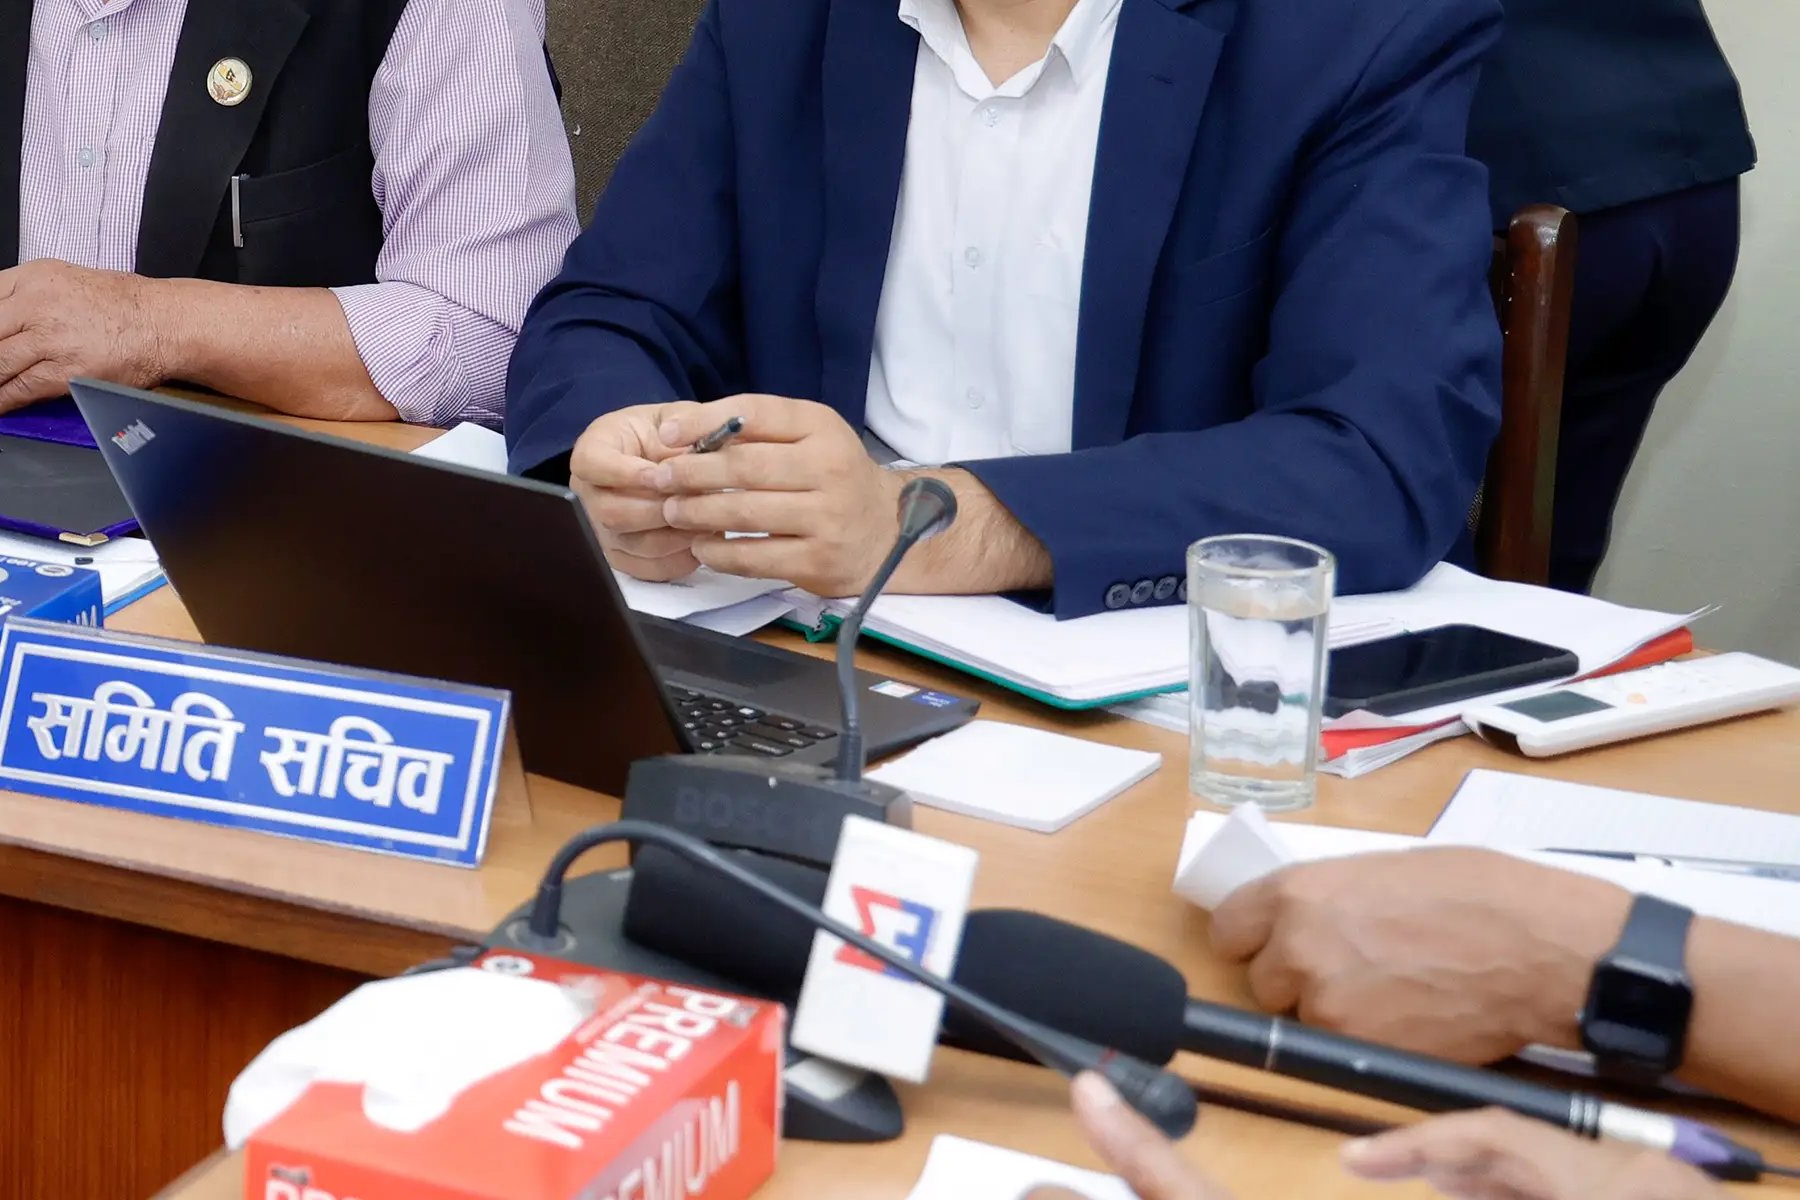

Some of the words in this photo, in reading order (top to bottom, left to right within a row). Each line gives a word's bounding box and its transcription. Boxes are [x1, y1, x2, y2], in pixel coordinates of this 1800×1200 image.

[26, 680, 245, 782] समिति
[258, 715, 454, 815] सचिव
[502, 984, 739, 1151] PREMIUM
